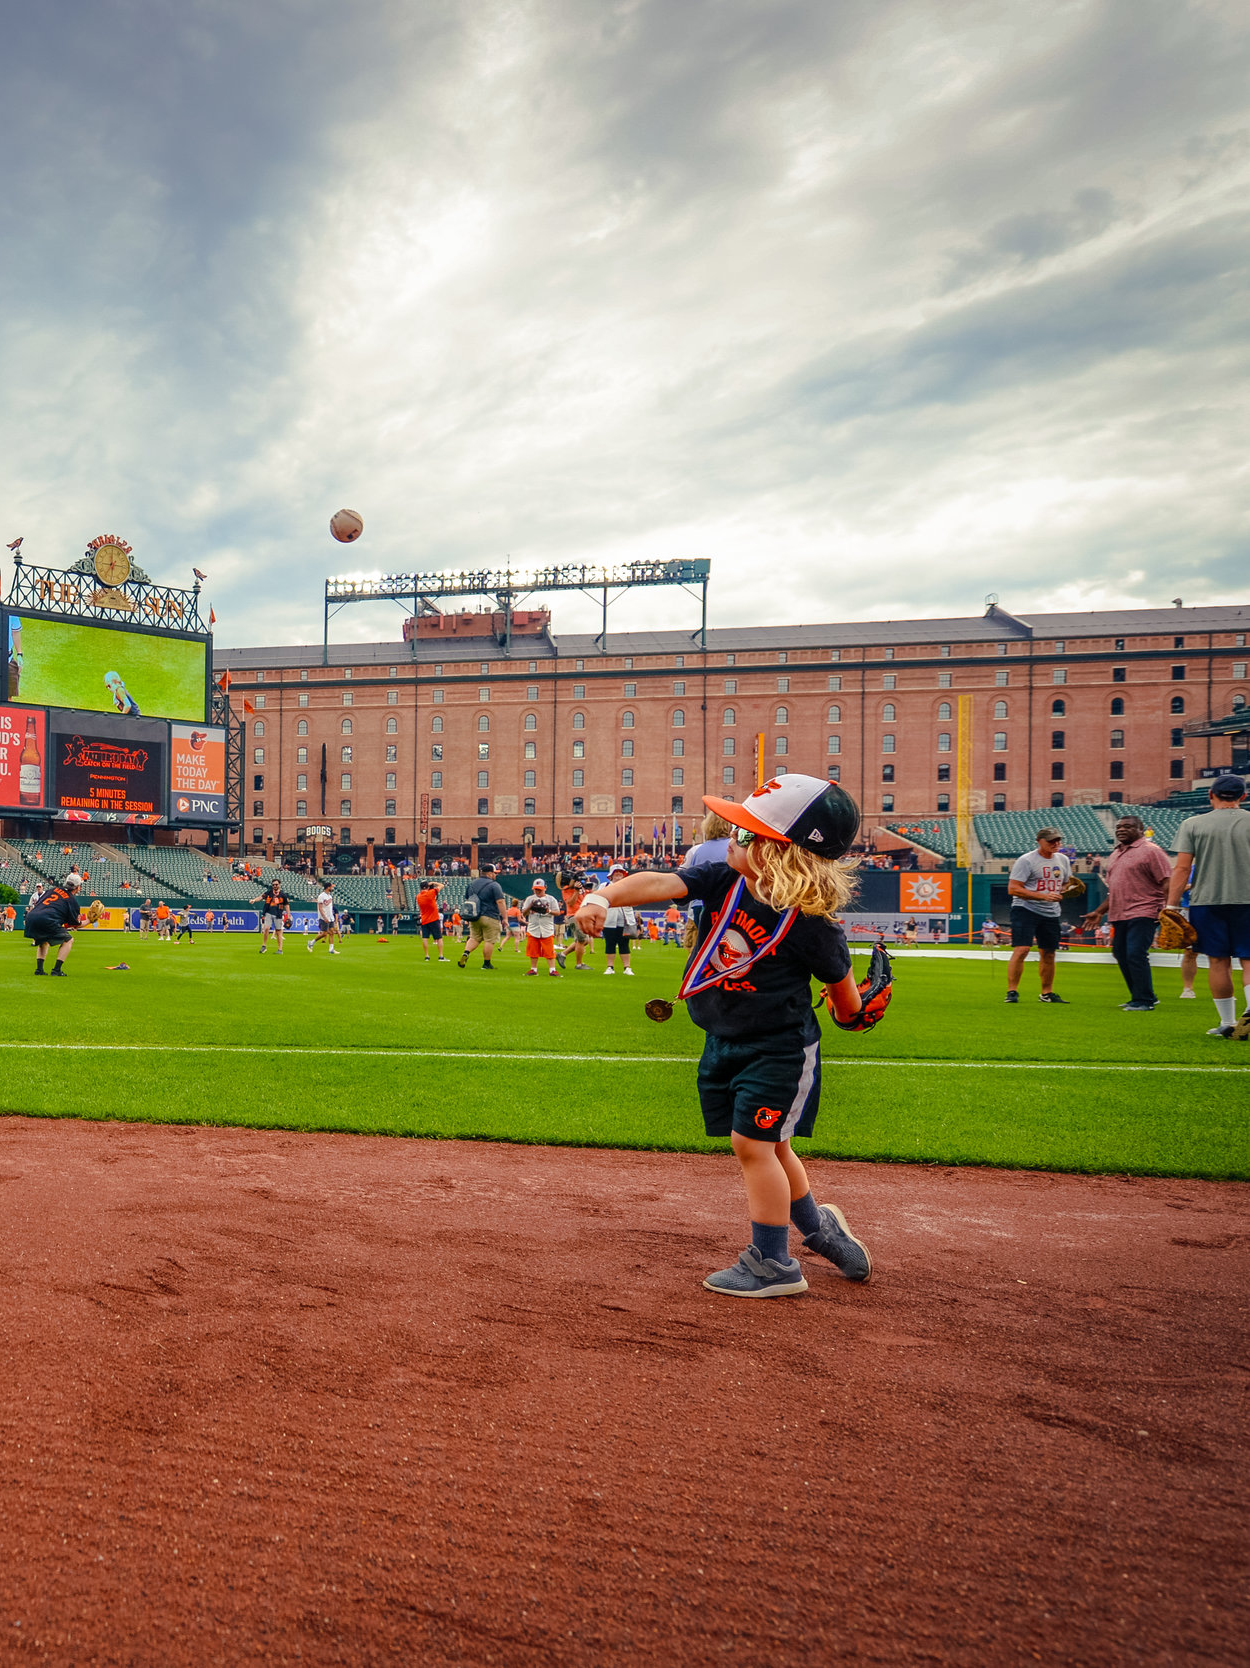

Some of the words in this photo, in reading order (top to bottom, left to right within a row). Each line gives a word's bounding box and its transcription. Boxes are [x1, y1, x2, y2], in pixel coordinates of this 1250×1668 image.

[35, 579, 80, 604] THE
[143, 595, 183, 620] SUN
[176, 753, 206, 766] MAKE
[176, 765, 208, 778] TODAY
[176, 777, 196, 790] THE
[89, 787, 95, 798] 5
[96, 787, 126, 799] MINUTES
[60, 796, 100, 808] REMAINING
[101, 799, 109, 809] IN
[110, 800, 123, 810] THE
[124, 801, 153, 812] SESSION
[191, 799, 219, 813] PNC
[1042, 866, 1051, 879] G
[42, 894, 59, 906] 2
